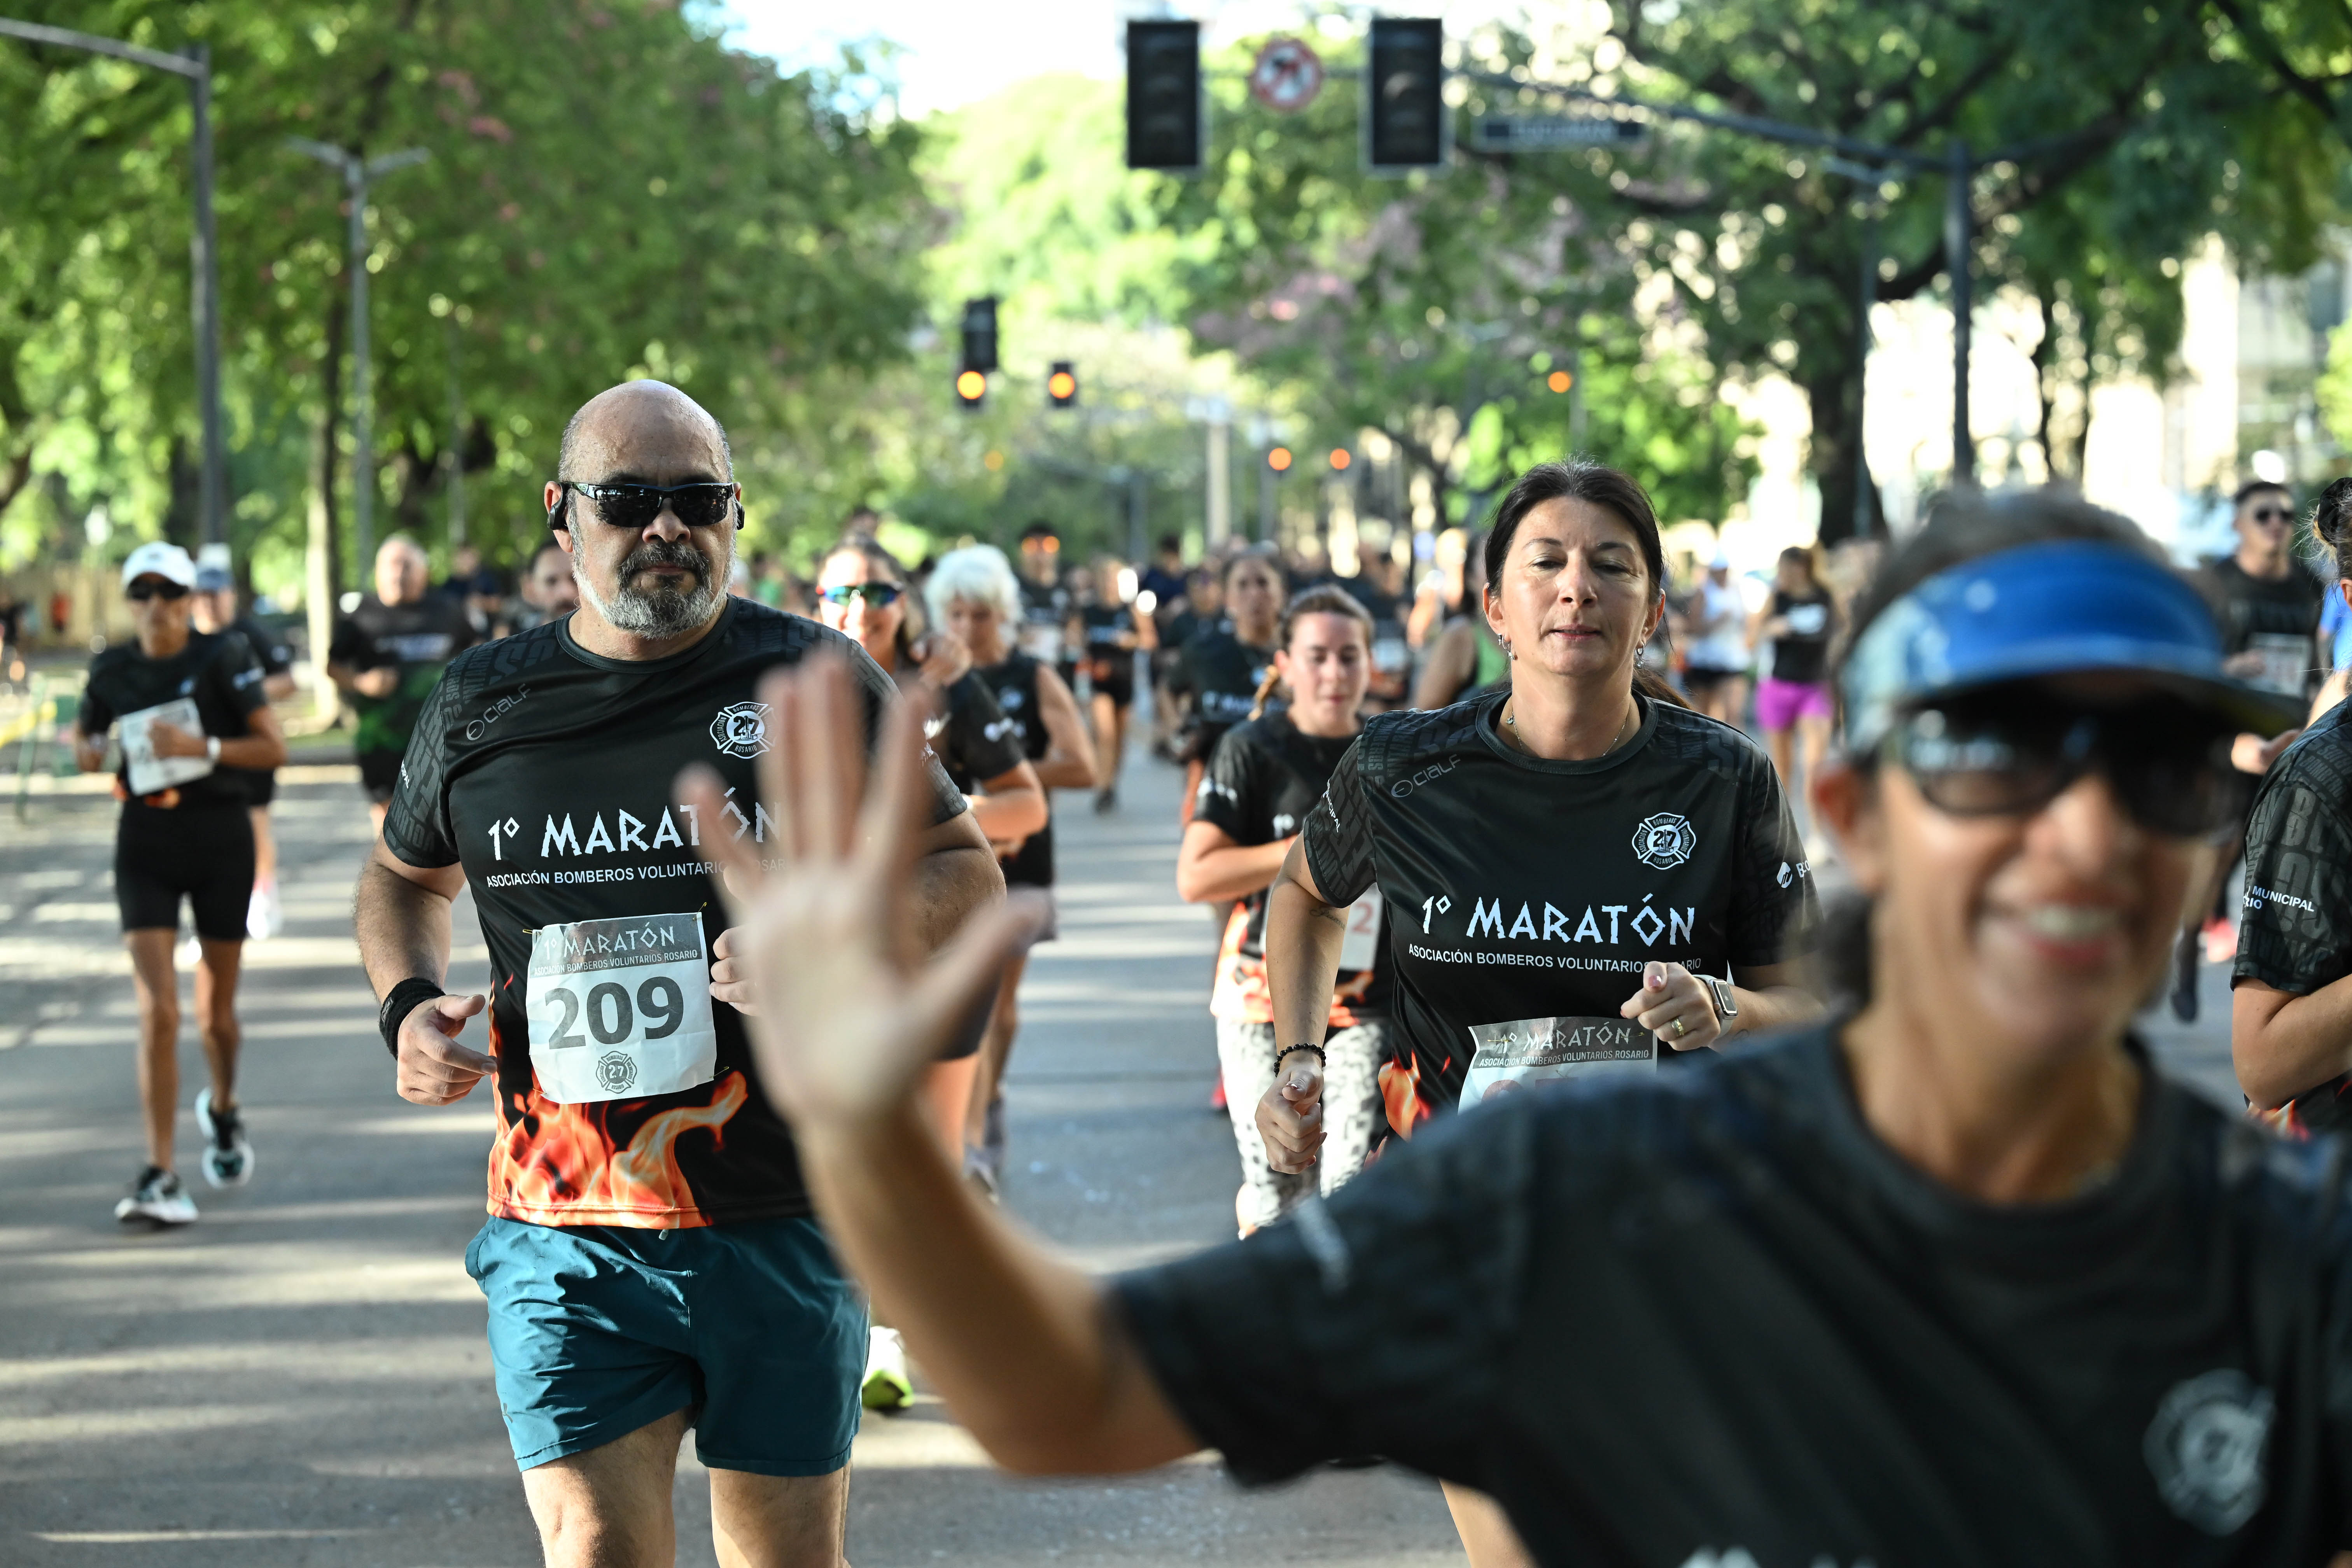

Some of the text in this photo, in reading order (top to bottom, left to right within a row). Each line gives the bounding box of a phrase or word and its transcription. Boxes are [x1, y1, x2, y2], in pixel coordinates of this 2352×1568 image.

[733, 716, 760, 737] 27
[735, 745, 757, 753] ROSARIO
[541, 786, 781, 858] MARATÓN
[1653, 818, 1677, 826] BOMBEROS
[1653, 830, 1677, 847] 27
[486, 870, 550, 888] ASOCIACIÓN
[555, 868, 634, 884] BOMBEROS
[638, 861, 724, 879] VOLUNTARI
[2252, 886, 2314, 912] MUNICIPAL
[1466, 892, 1695, 947] MARATÓN
[564, 922, 675, 957] MARATÓN
[534, 949, 698, 976] ASOCIACIÓN BOMBEROS VOLUNTARIOS ROSARIO
[1409, 943, 1473, 964] ASOCIACIÓN
[1477, 952, 1554, 968] BOMBEROS
[544, 976, 684, 1050] 209
[1523, 1021, 1631, 1051] MARATÓN
[1521, 1054, 1561, 1065] BOMBEROS
[1562, 1050, 1613, 1062] VOLUNTARIOS
[1615, 1050, 1649, 1059] ROSARIO
[608, 1065, 624, 1079] 27
